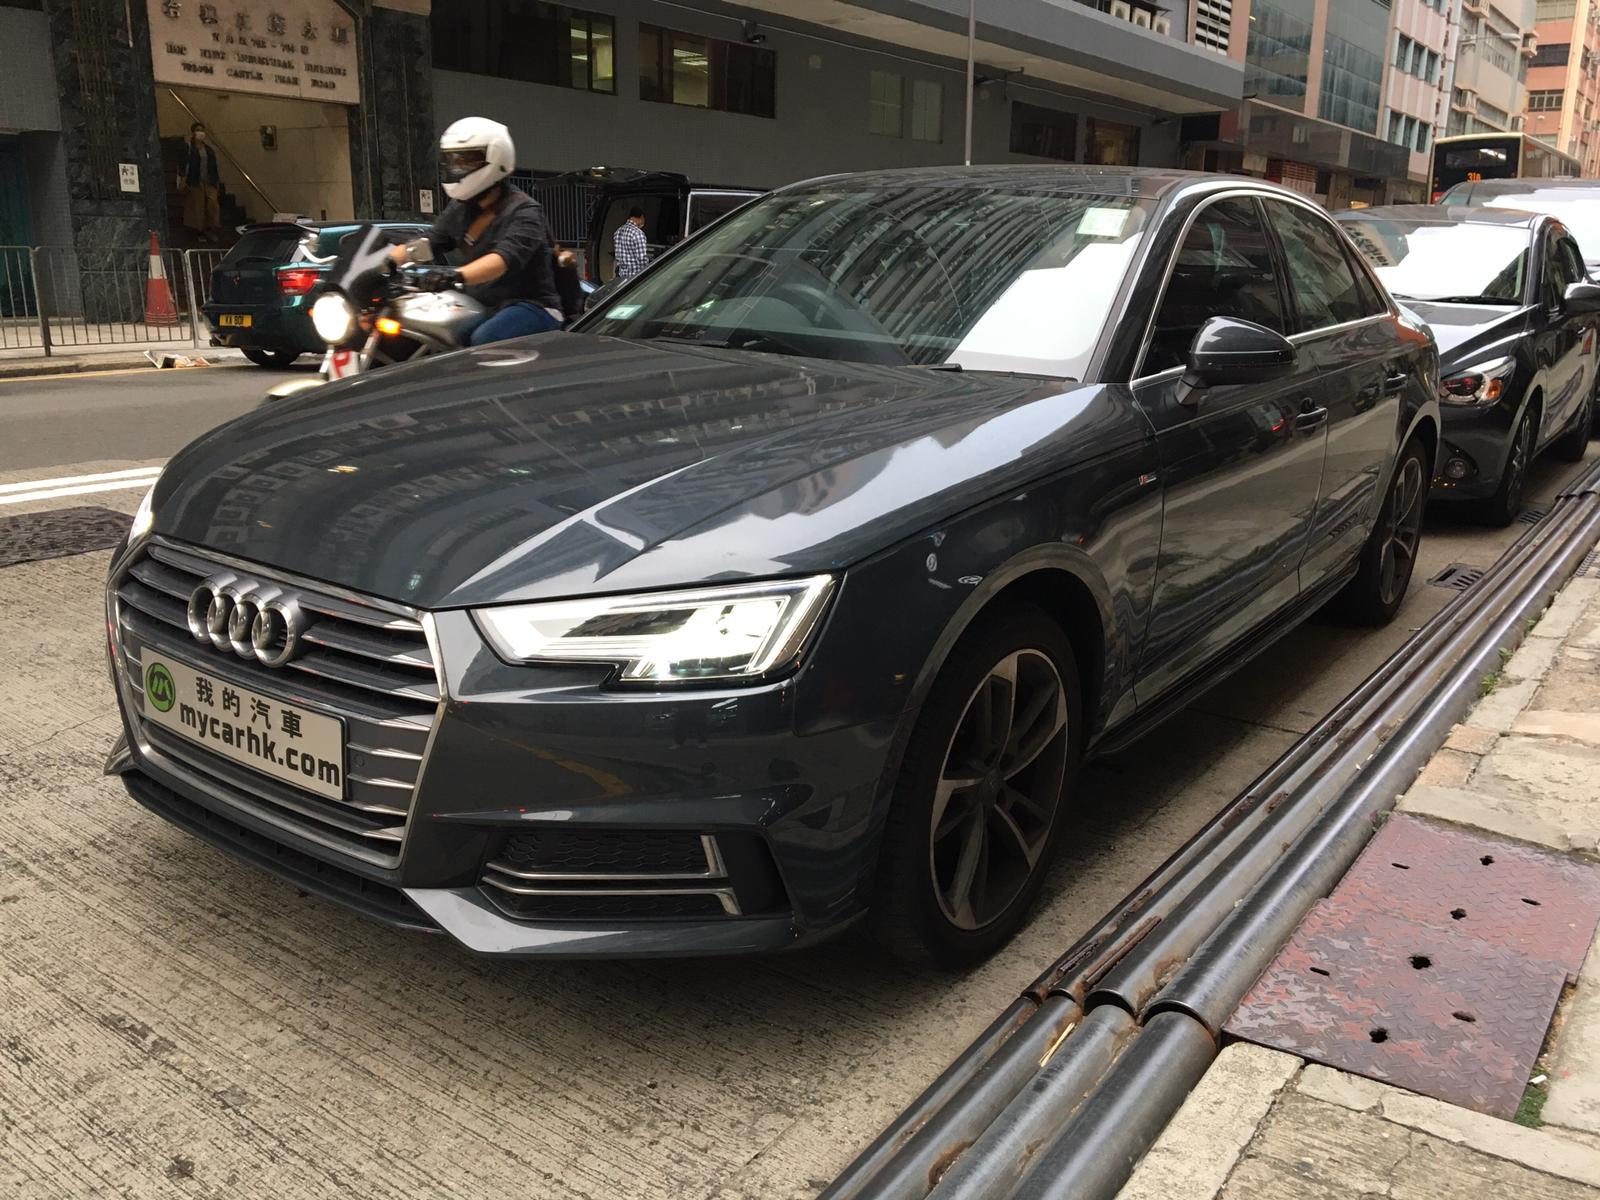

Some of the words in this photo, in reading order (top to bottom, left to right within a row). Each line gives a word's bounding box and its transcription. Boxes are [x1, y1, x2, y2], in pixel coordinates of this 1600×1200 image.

[226, 67, 264, 81] CASTLE
[195, 676, 303, 739] 我的汽車
[179, 702, 341, 788] mycarhk.com
